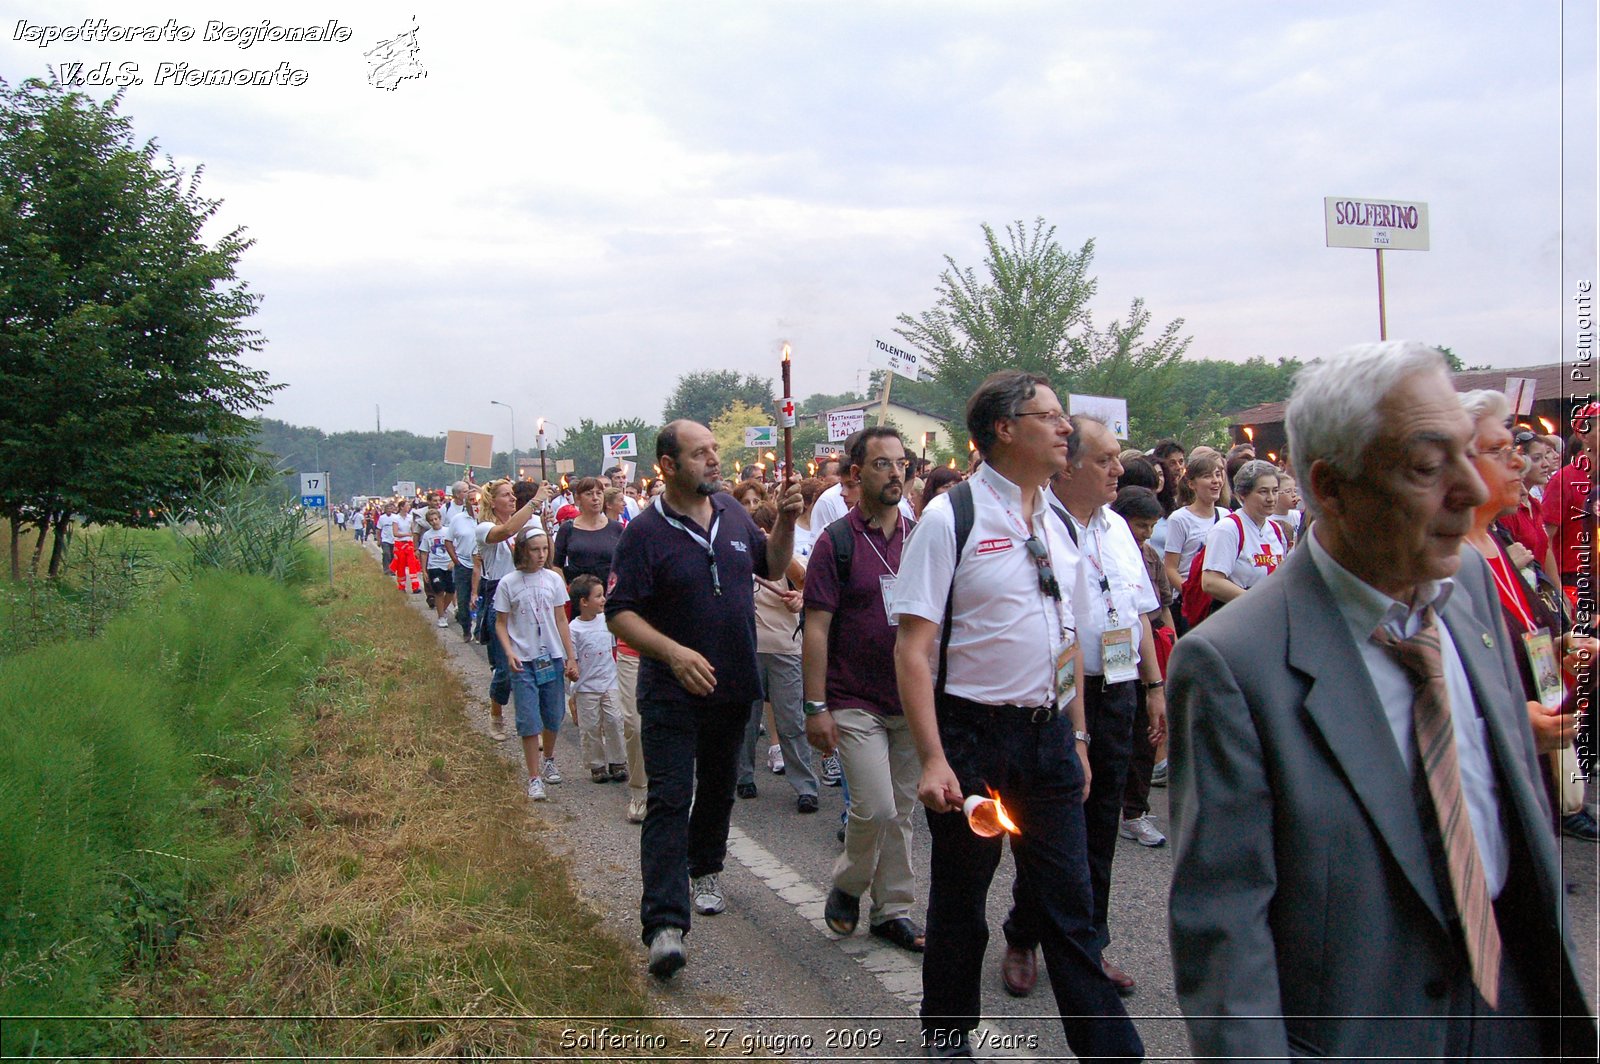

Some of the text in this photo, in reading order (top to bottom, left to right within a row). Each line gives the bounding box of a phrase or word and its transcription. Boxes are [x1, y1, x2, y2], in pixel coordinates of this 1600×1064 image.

[1335, 201, 1419, 230] SOLFERINO
[875, 339, 917, 364] TOLENTINO
[888, 361, 900, 369] ITALY
[832, 427, 857, 438] ITALY
[821, 446, 836, 454] 100
[307, 479, 319, 489] 17
